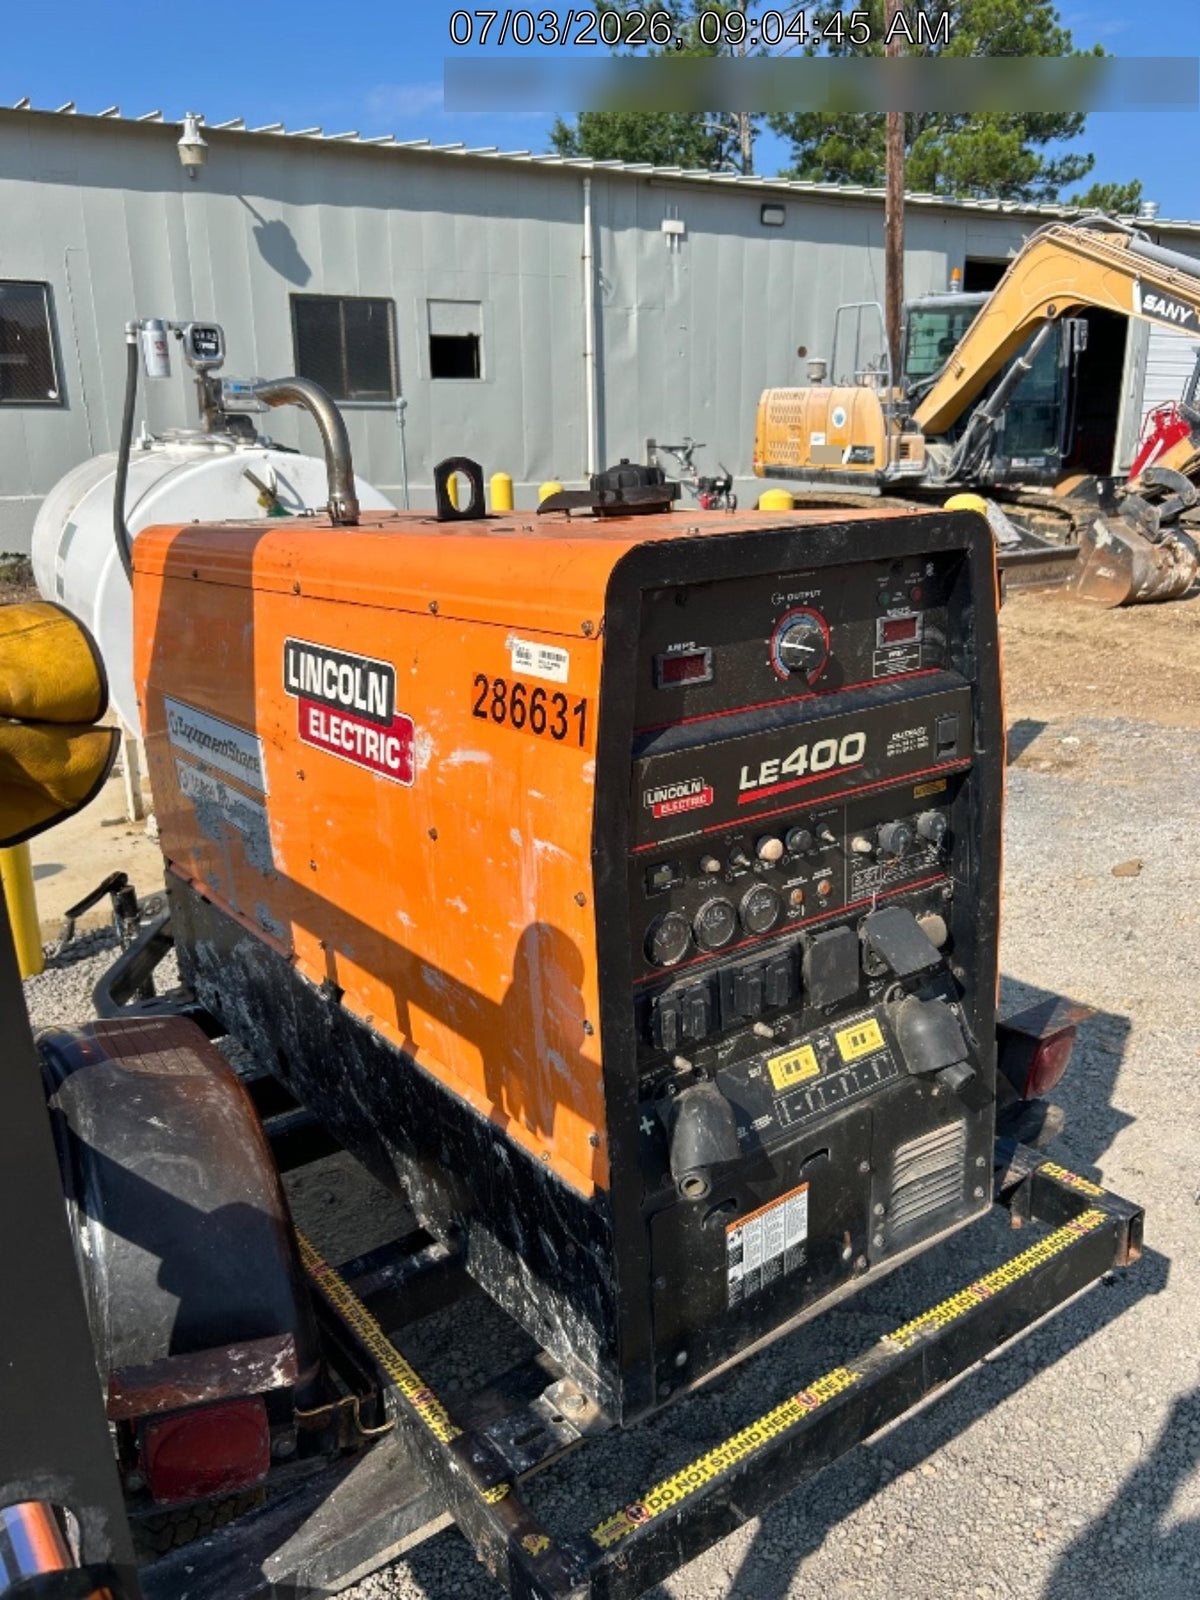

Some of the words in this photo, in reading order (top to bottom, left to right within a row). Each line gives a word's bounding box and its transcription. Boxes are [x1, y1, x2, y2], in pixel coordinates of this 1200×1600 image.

[1142, 294, 1194, 323] SANY
[787, 589, 821, 601] OUTPUT
[288, 648, 388, 718] LINCOLN
[472, 673, 588, 748] 286631
[308, 707, 401, 769] ELECTRIC
[739, 731, 867, 791] LE400
[646, 781, 702, 804] LINCOLN
[660, 793, 707, 814] ELECTRIC
[370, 1332, 408, 1375] DEBOUT
[815, 1379, 838, 1396] NE
[427, 1404, 445, 1423] NO
[647, 1488, 676, 1511] DO
[675, 1463, 710, 1492] NOT
[709, 1431, 763, 1468] STAND
[761, 1403, 802, 1435] HERE
